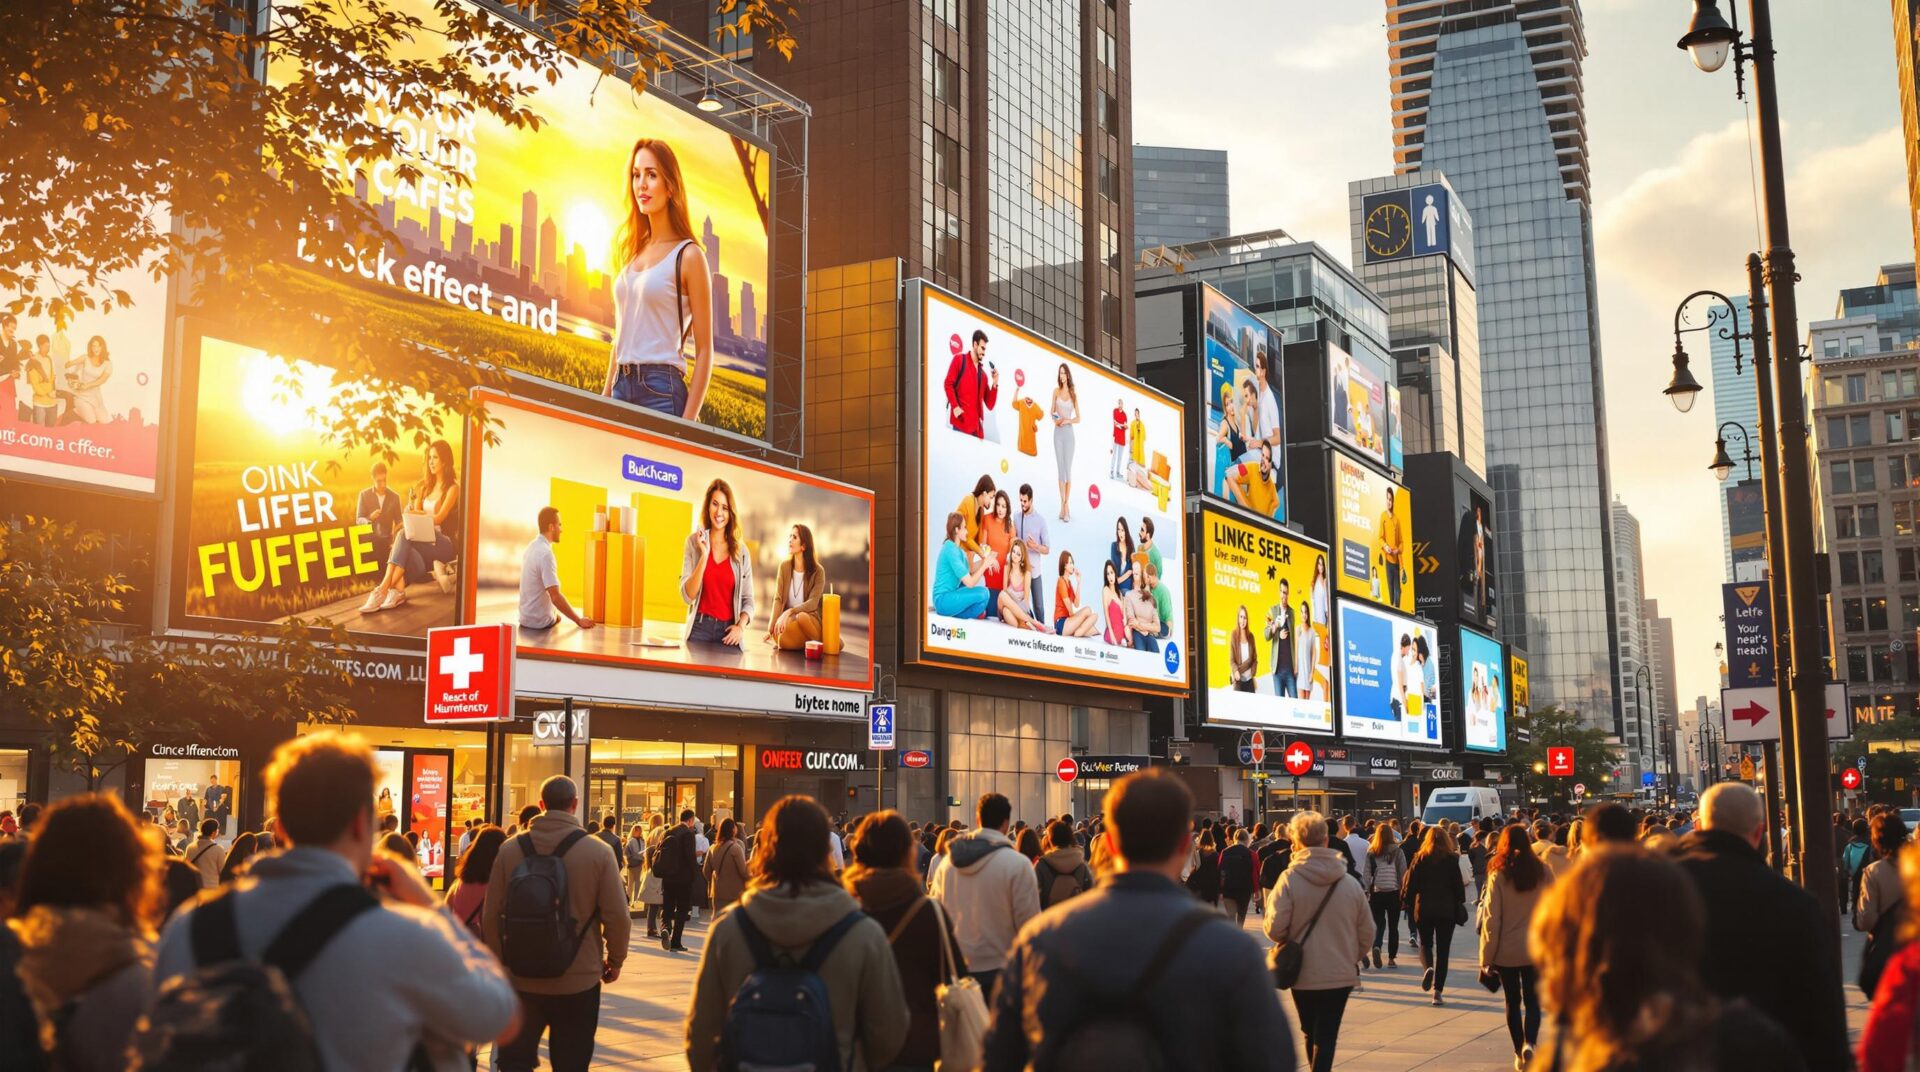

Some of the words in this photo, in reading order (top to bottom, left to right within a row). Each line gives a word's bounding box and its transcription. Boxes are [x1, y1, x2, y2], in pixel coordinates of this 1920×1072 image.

[372, 160, 475, 224] CAFES
[403, 260, 493, 316] effect
[501, 295, 558, 337] and
[55, 440, 65, 451] a
[241, 460, 324, 494] OINK
[236, 490, 338, 533] LIFER
[197, 523, 380, 598] FUFFEE
[1214, 521, 1256, 554] LINKE
[1258, 536, 1292, 566] SEER
[1737, 624, 1760, 634] Your
[468, 690, 480, 701] of
